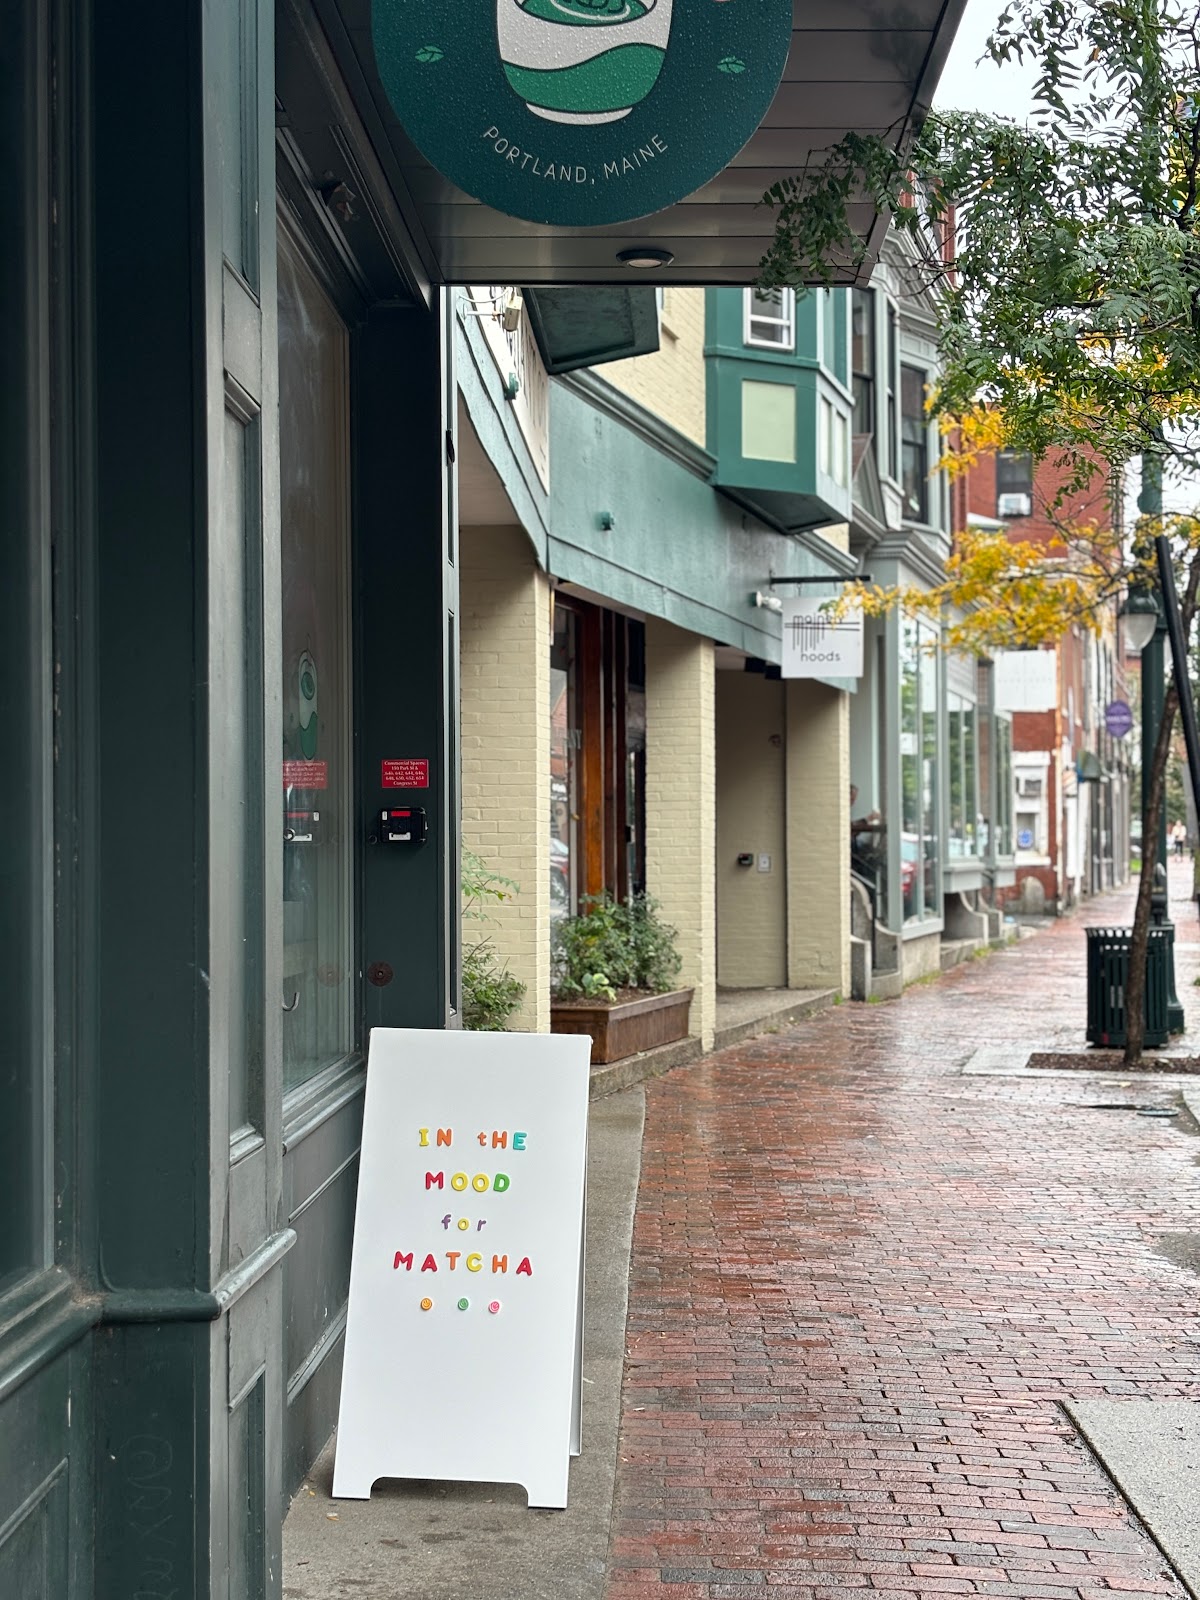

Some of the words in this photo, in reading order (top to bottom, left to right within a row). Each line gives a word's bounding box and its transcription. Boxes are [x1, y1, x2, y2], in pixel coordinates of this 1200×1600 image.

[482, 125, 596, 185] PORTLAND,
[603, 133, 669, 180] MAINE
[800, 651, 841, 662] noods
[418, 1128, 453, 1147] IN
[425, 1171, 511, 1193] MOOD
[441, 1213, 487, 1232] for
[393, 1250, 533, 1276] MATCHA
